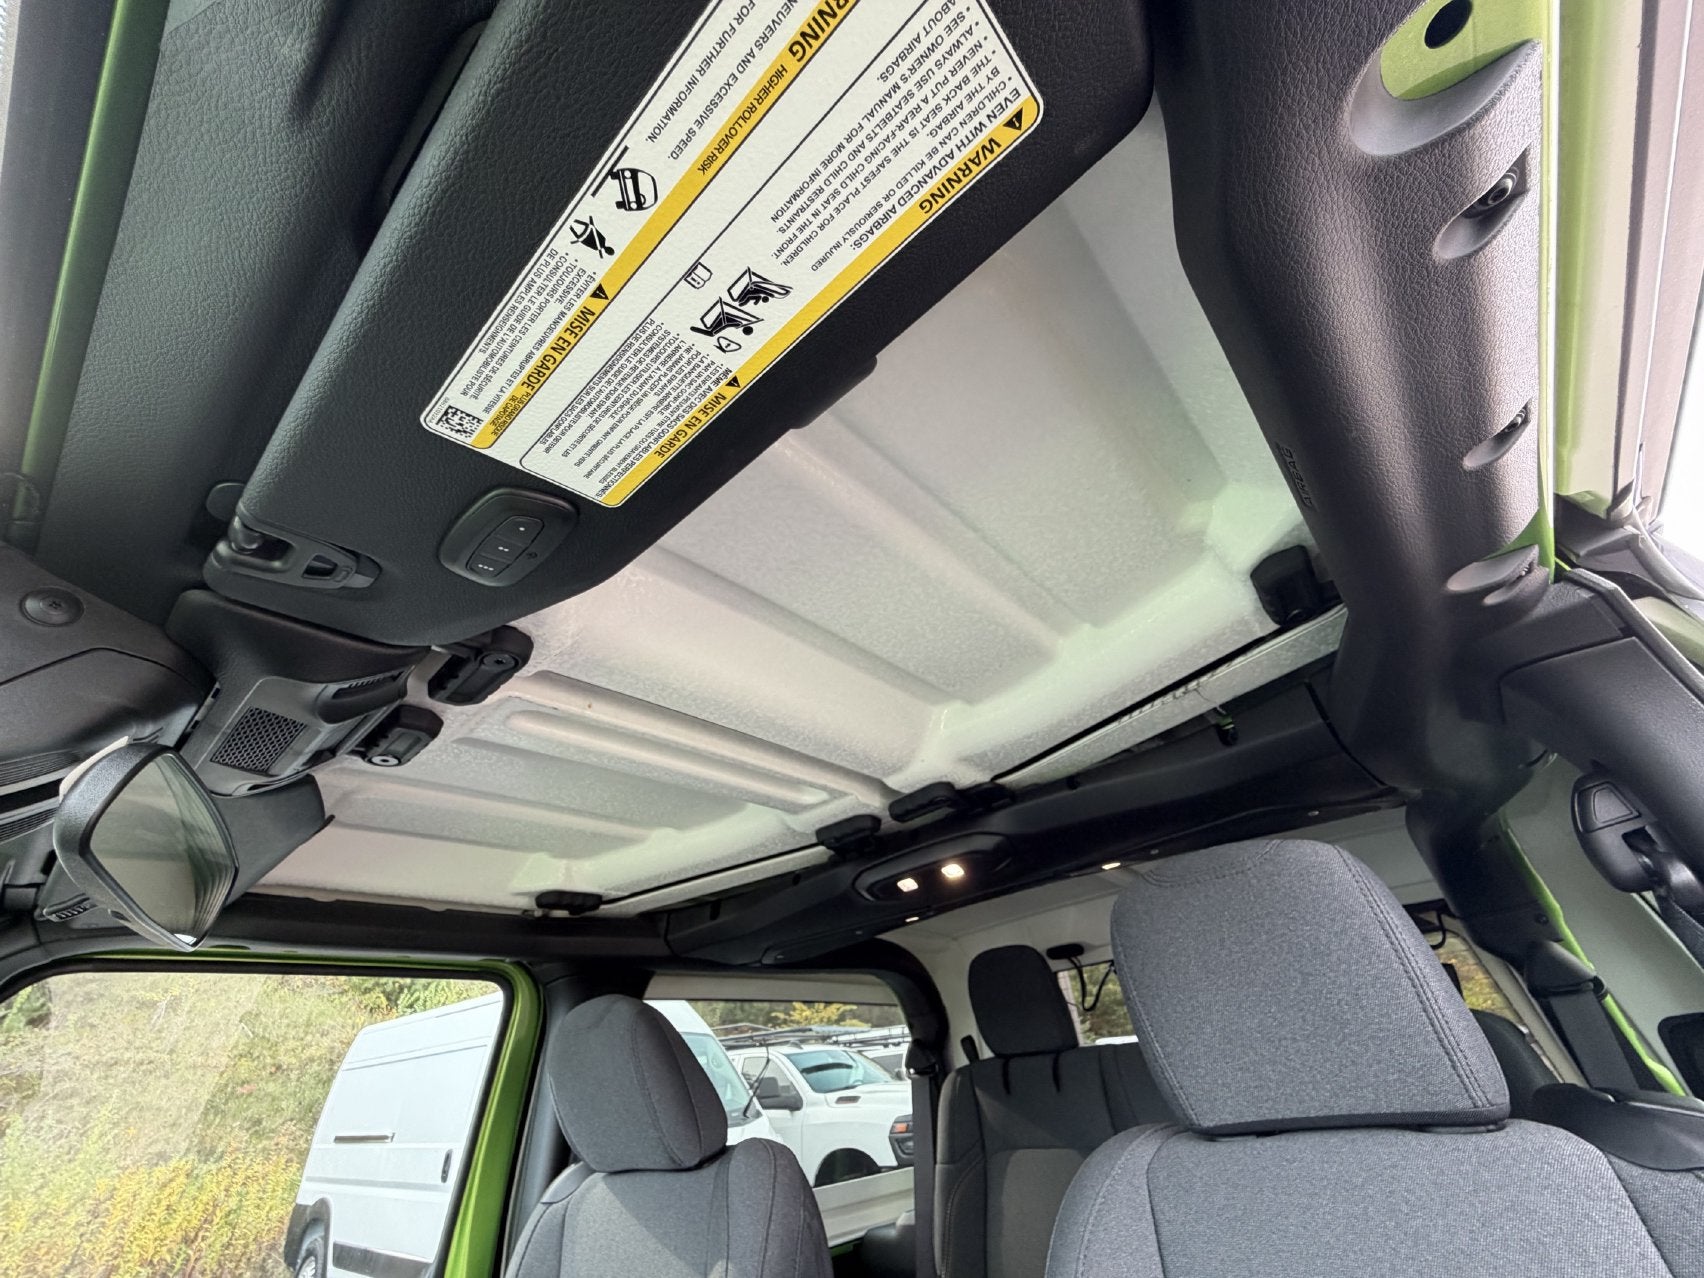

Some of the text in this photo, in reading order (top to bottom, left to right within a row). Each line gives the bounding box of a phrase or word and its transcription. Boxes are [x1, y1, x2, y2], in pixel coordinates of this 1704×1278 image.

[646, 0, 755, 142] FOR FURTHER INFORMATION.
[737, 47, 755, 74] AND
[877, 0, 955, 82] ABOUT AIRBAGS.
[694, 72, 738, 129] EXCESSIVE
[754, 64, 788, 105] HIGHER
[771, 12, 965, 222] SEE OWNER'S MANUAL FOR MORE INFORMATION
[927, 66, 1000, 138] BY THE AIRBAG.
[668, 128, 696, 160] SPEED.
[698, 151, 718, 175] RISK
[714, 102, 757, 154] ROLLOVER
[772, 40, 982, 259] NEVER PUT A REAR-FACING CHILD SEAT IN THE FRONT.
[777, 24, 973, 233] ALWAYS USE SEATBELTS AND CHILD RESTRAINTS.
[781, 55, 991, 266] THE BACK SEAT IS THE SAFEST PLACE FOR CHILDREN.
[812, 81, 1006, 271] CHILDREN CAN BE KILLED OR SERIOUSLY INJURED
[850, 88, 1021, 250] EVEN WITH ADVANCED AIRBAGS:
[919, 138, 1001, 214] WARNING
[521, 306, 596, 391] MISE EN GARDE
[654, 393, 726, 458] MISE EN GARDE
